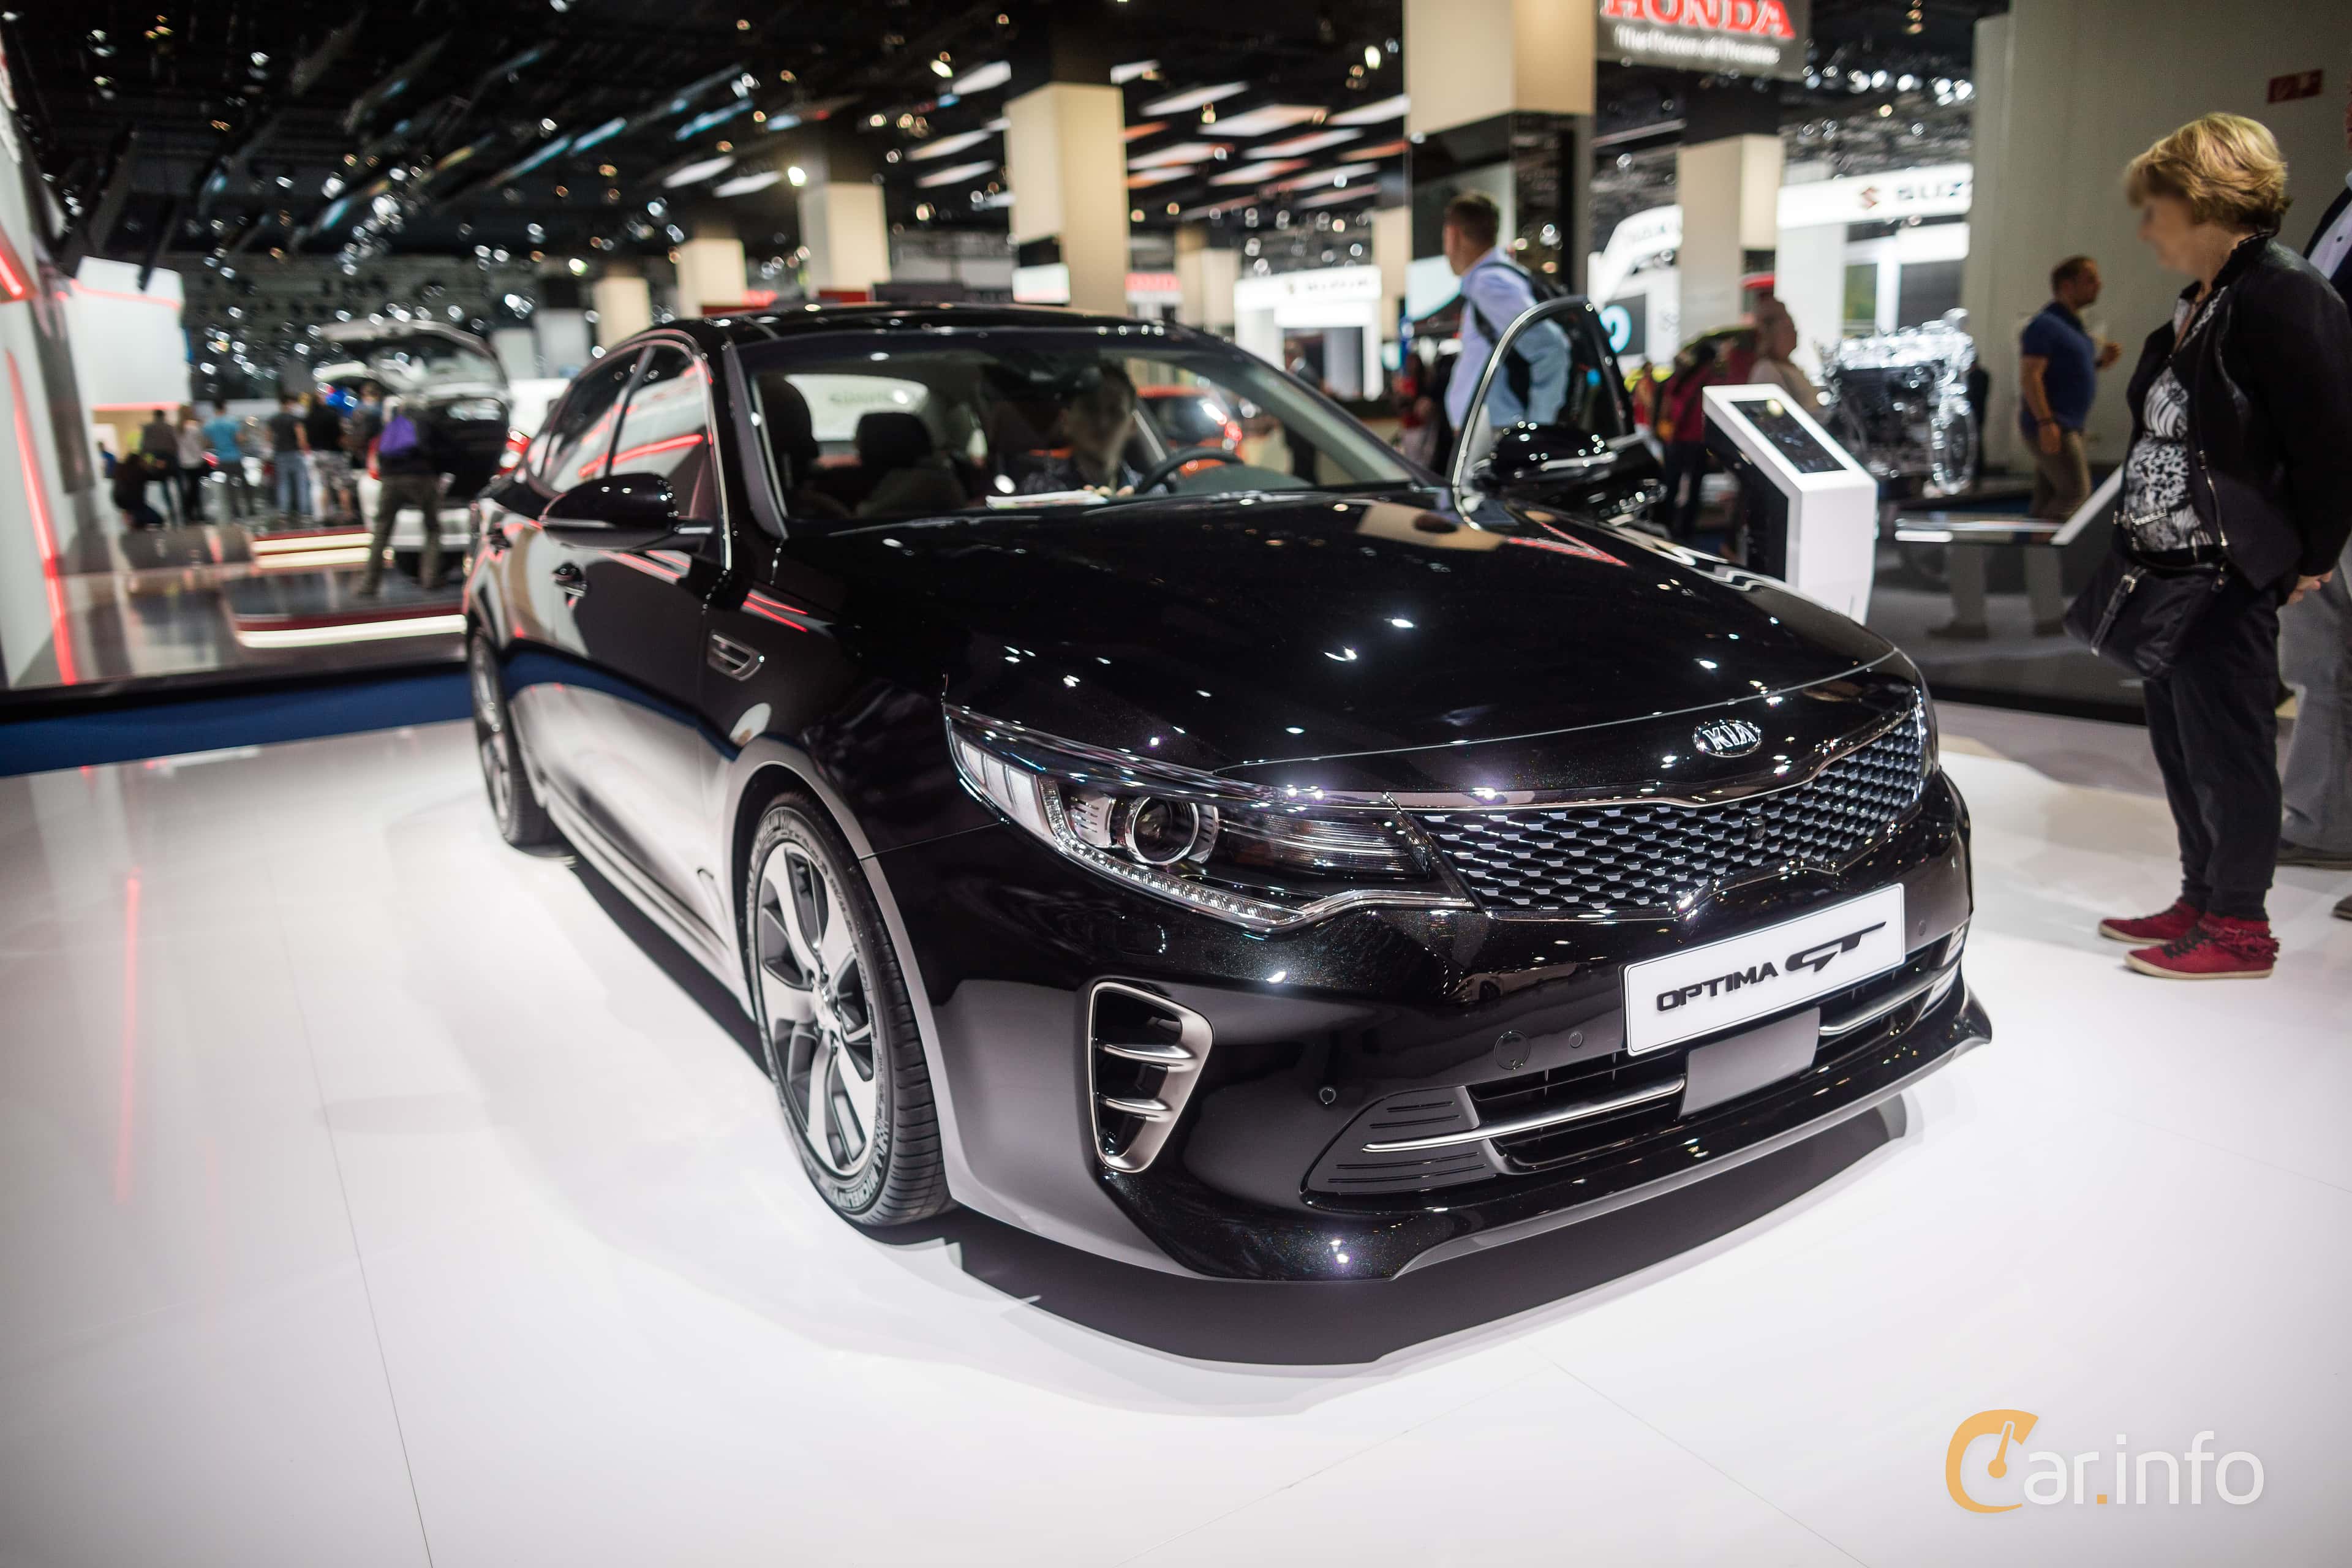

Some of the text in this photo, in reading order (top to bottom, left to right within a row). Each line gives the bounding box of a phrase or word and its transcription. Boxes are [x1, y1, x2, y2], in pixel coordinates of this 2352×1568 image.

[1599, 0, 1796, 39] HONDA
[1896, 181, 1972, 201] SUZ
[1702, 723, 1757, 751] KIA
[1656, 921, 1887, 1012] OPTIMA GT
